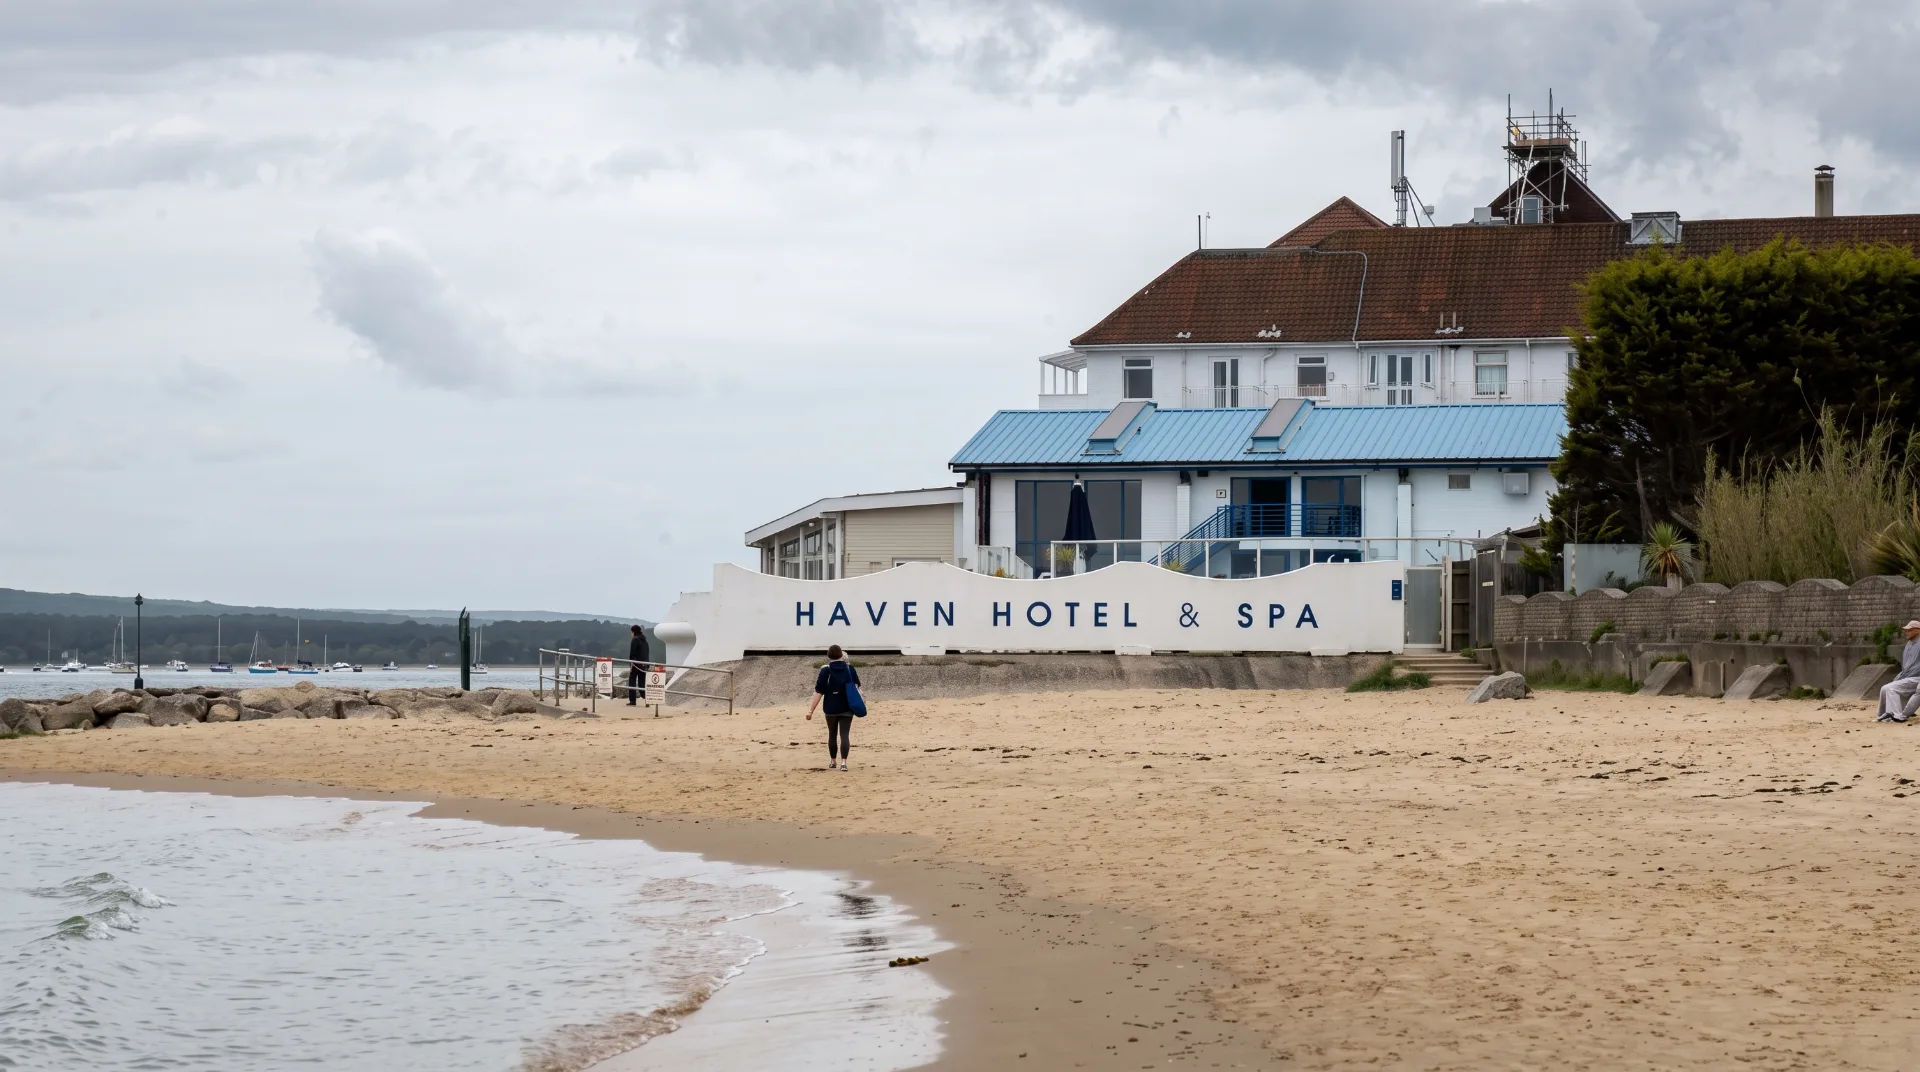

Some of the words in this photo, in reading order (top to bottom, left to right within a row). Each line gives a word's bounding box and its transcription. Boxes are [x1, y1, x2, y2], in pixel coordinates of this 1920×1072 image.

[796, 601, 954, 627] HAVEN
[993, 601, 1137, 627] HOTEL
[1179, 602, 1199, 628] &
[1238, 603, 1319, 628] SPA
